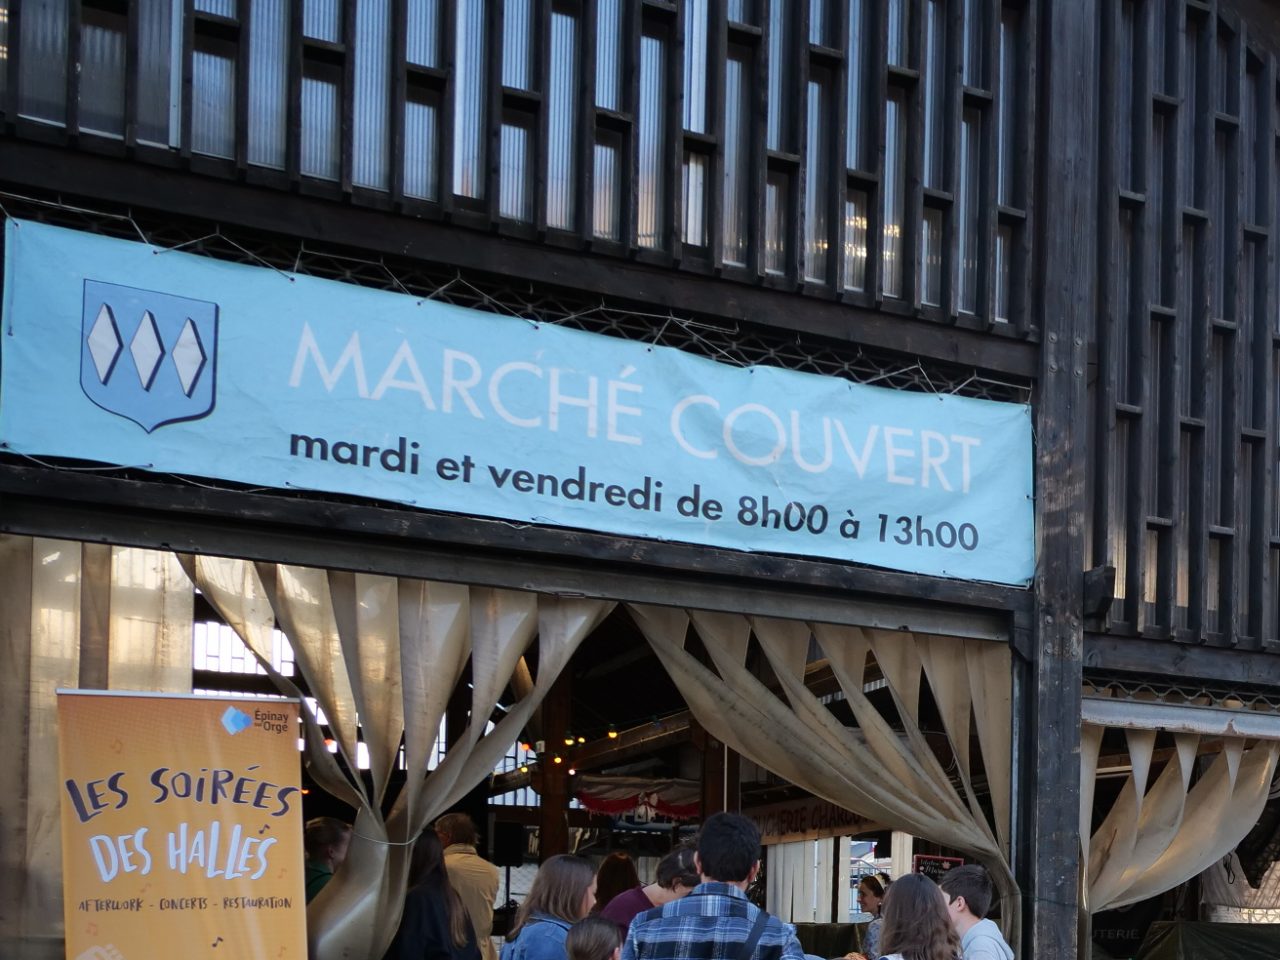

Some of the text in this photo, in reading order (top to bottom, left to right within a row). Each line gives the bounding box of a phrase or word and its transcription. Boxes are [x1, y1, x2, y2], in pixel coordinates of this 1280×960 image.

[289, 320, 981, 494] MARCHÉ COUVERT
[289, 433, 979, 551] mardi et vendredi de 8h00 à 13h00
[254, 708, 289, 724] Épinay
[263, 721, 289, 735] Orge
[65, 771, 129, 823] LES
[89, 821, 278, 883] DES HALLES
[78, 898, 144, 912] AFTERWORK
[159, 897, 208, 911] CONCERTS
[223, 896, 292, 910] RESTAURATION
